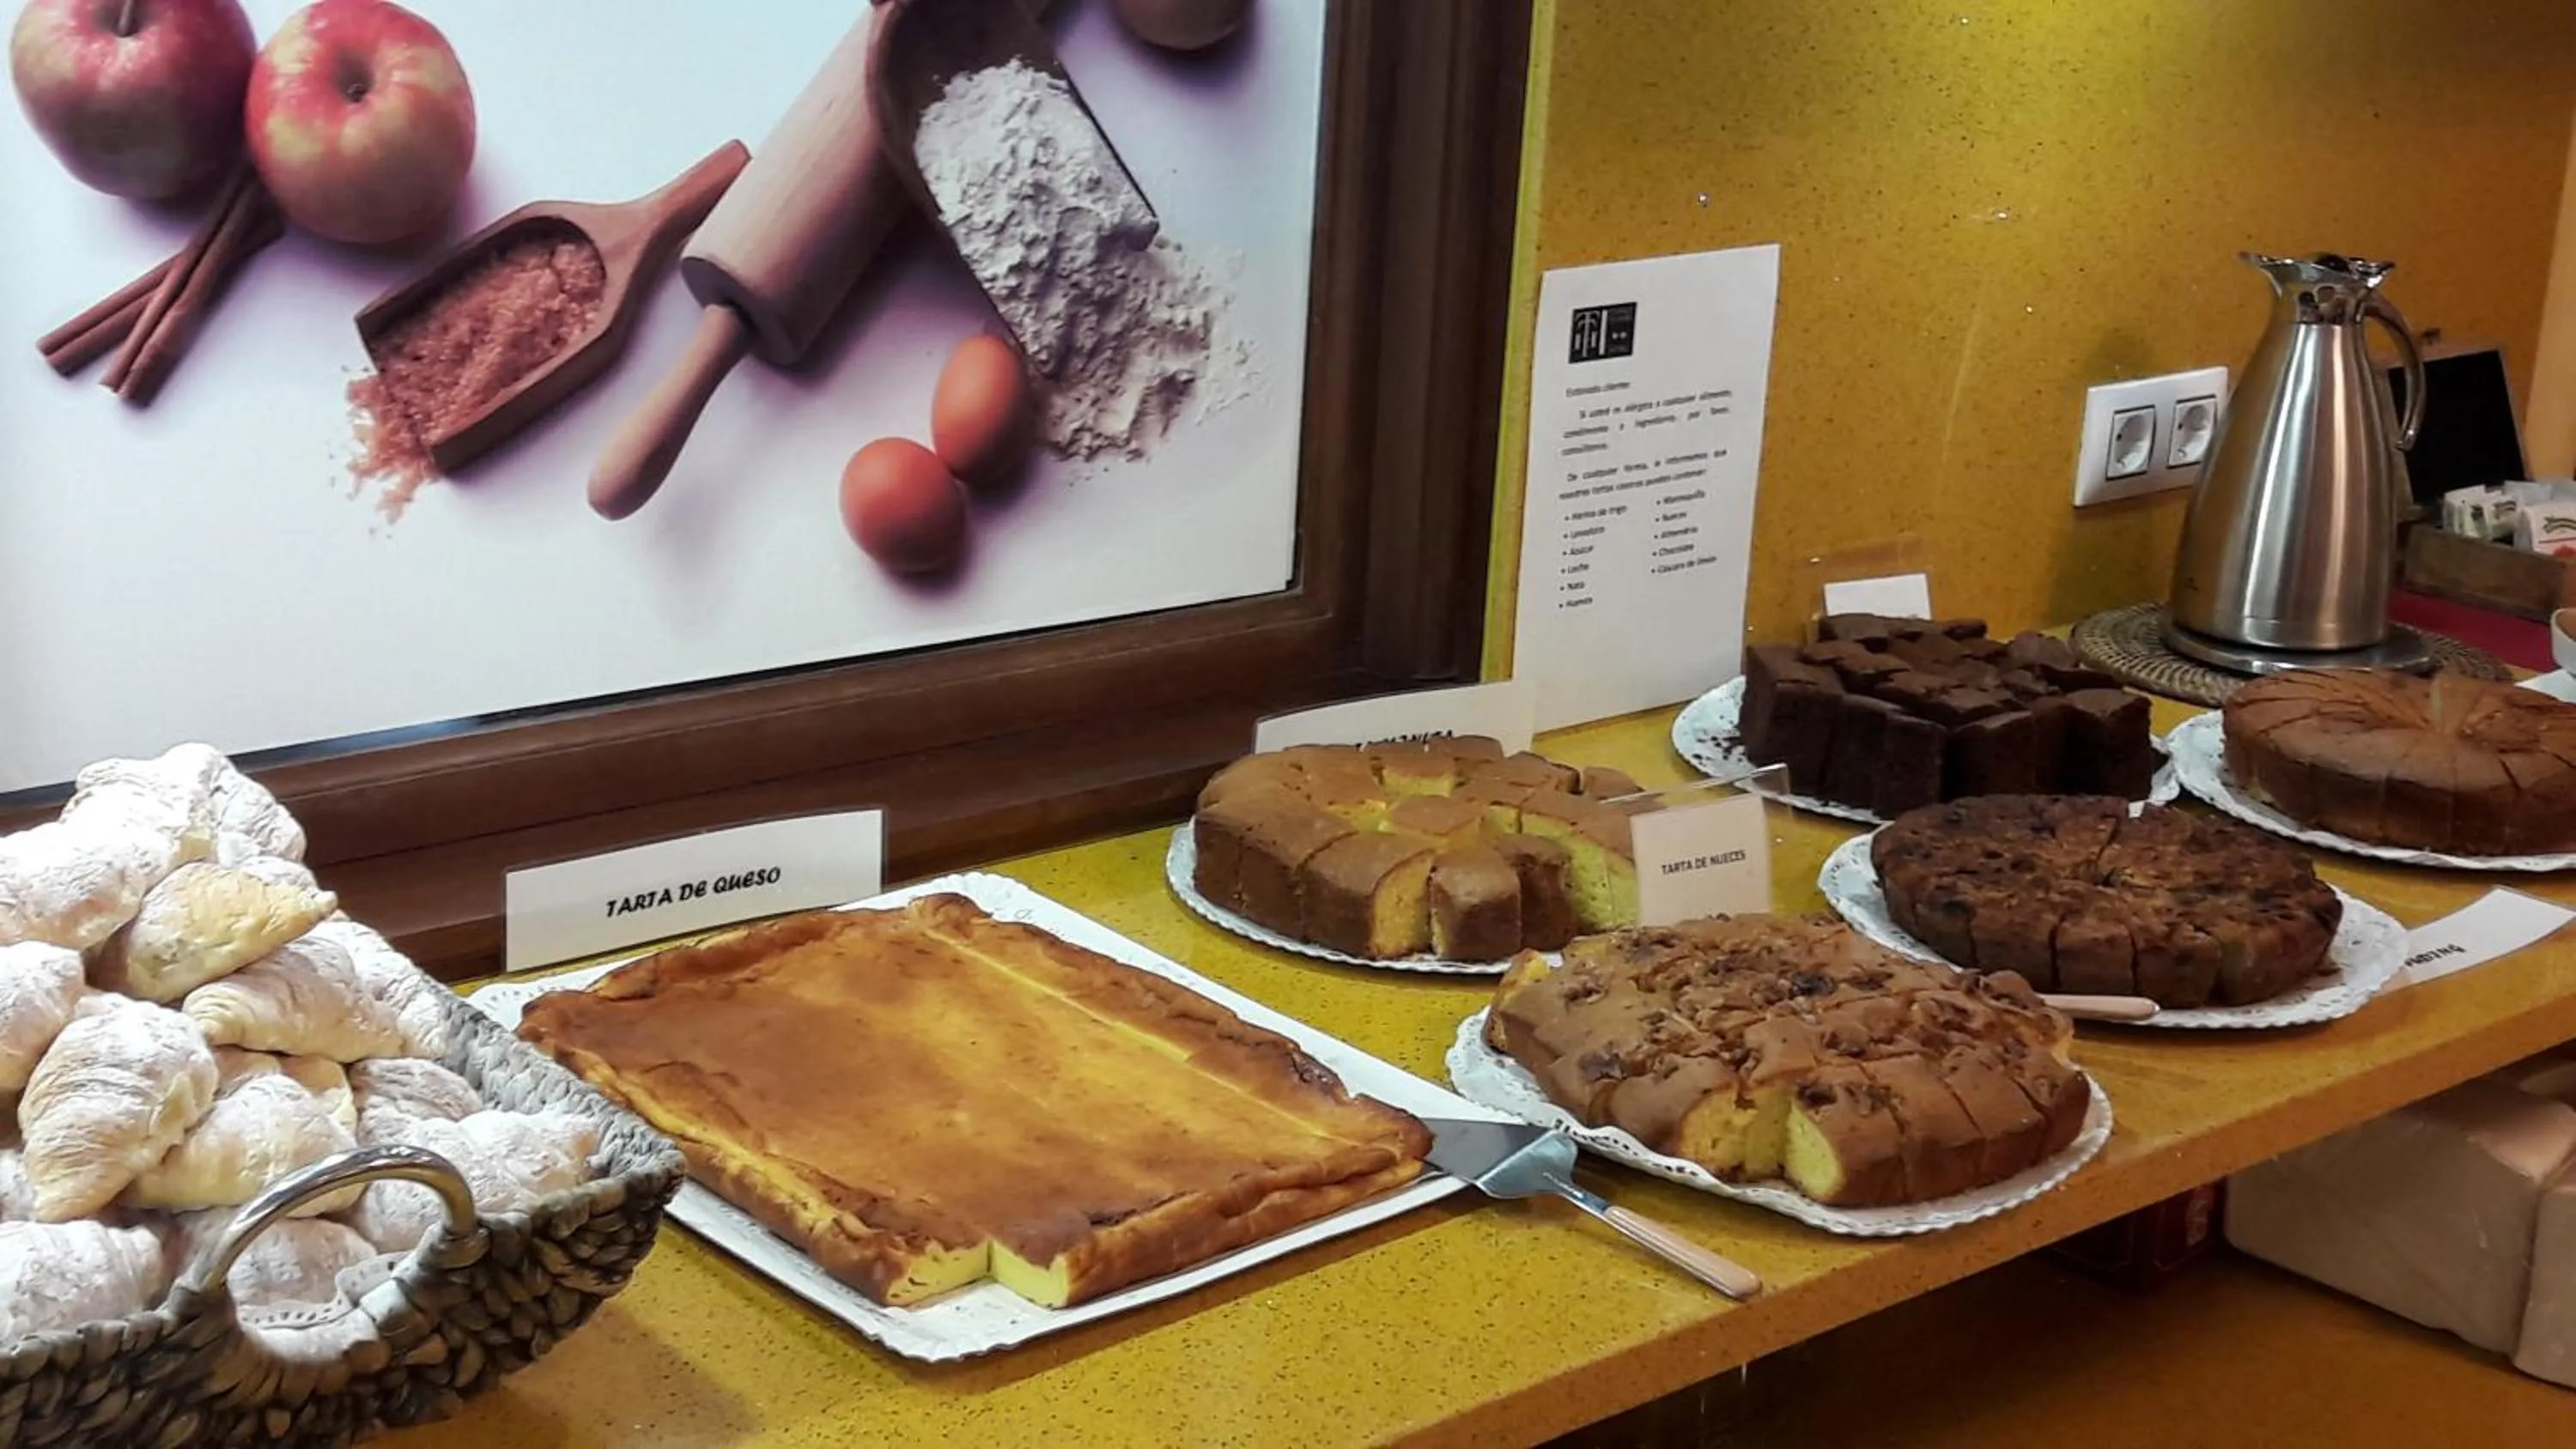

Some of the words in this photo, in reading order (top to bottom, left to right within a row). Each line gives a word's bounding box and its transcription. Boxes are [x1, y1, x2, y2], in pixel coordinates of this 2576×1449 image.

[1661, 858, 1692, 876] TARTA
[1695, 856, 1708, 870] DE
[1710, 849, 1746, 866] NUECES
[605, 887, 673, 918] TARTA
[678, 878, 708, 902] DE
[713, 865, 782, 894] QUESO
